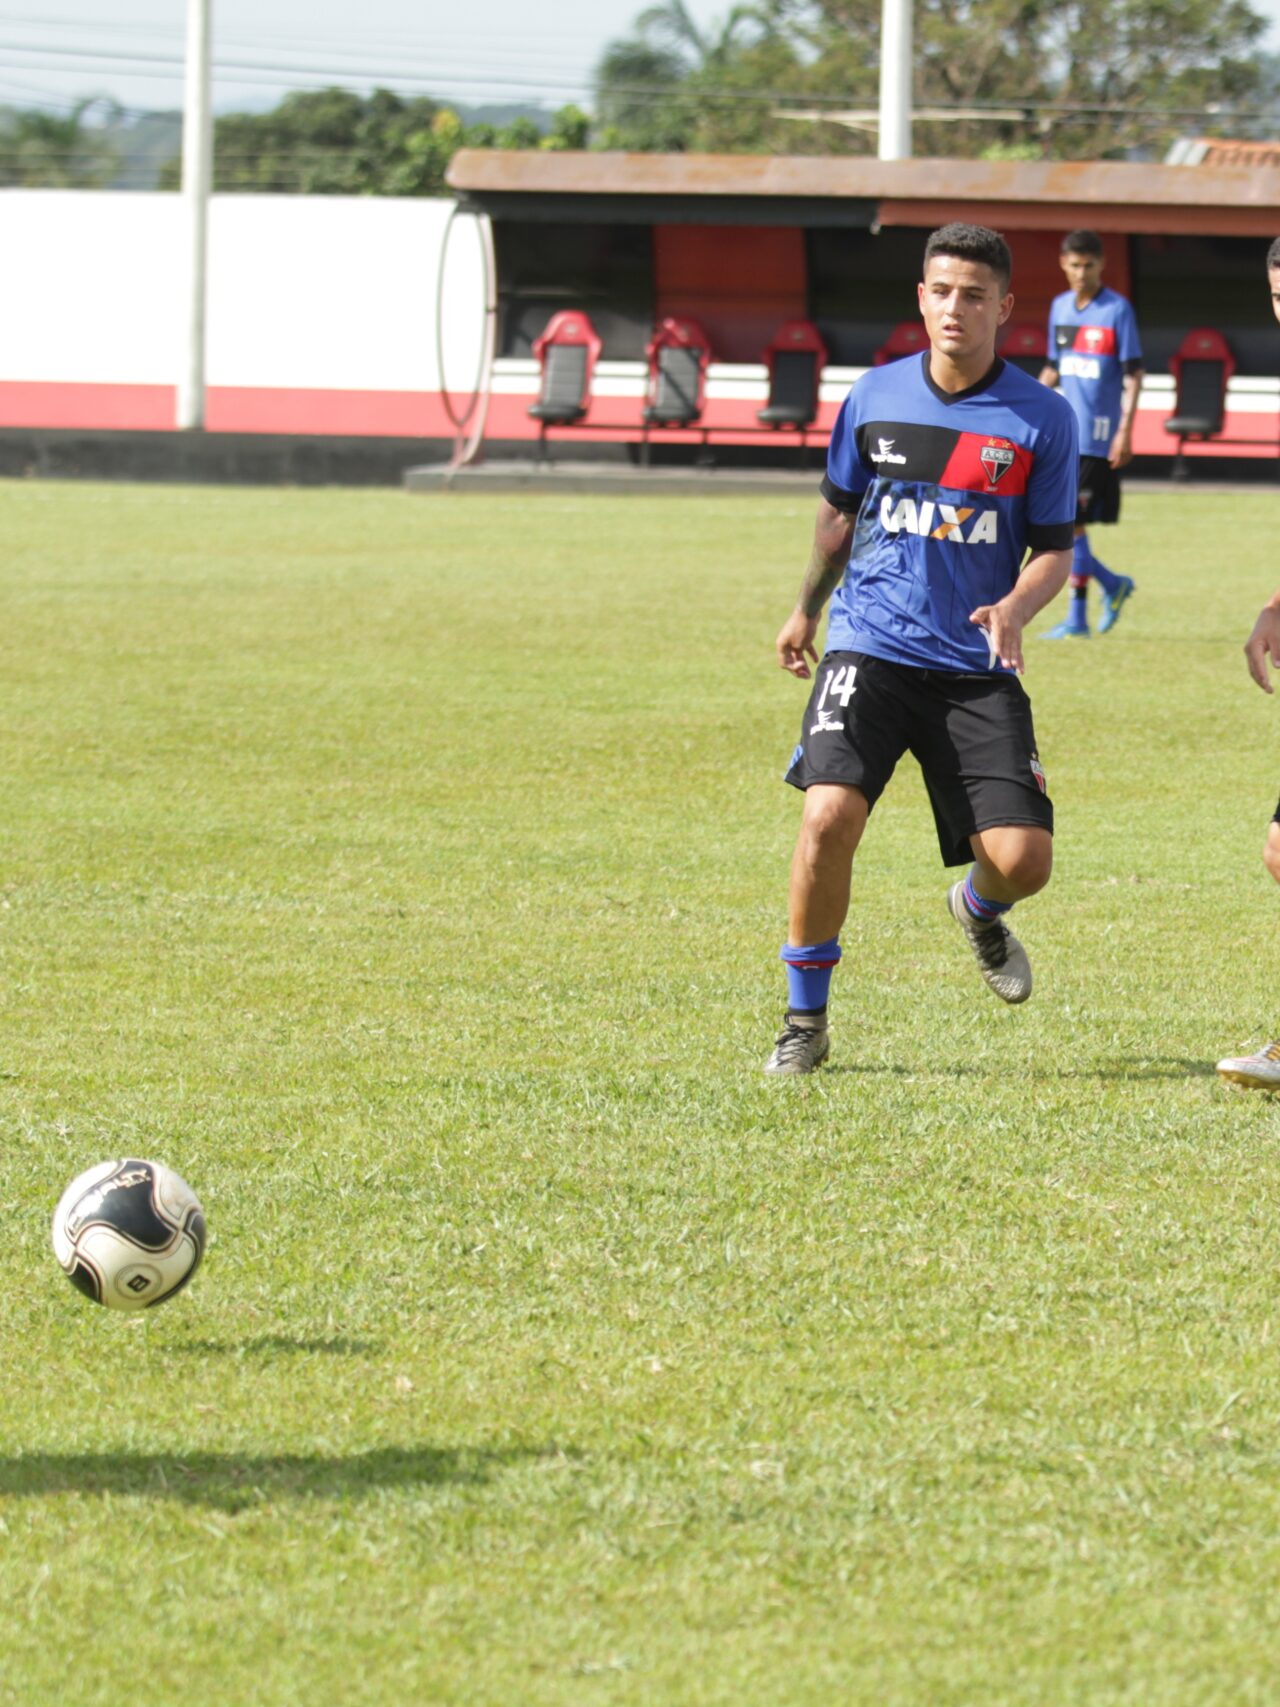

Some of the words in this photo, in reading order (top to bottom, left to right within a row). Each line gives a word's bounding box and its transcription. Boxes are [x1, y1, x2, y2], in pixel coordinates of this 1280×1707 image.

[1093, 416, 1111, 441] 11
[880, 495, 998, 544] CAIXA
[816, 665, 858, 711] 14
